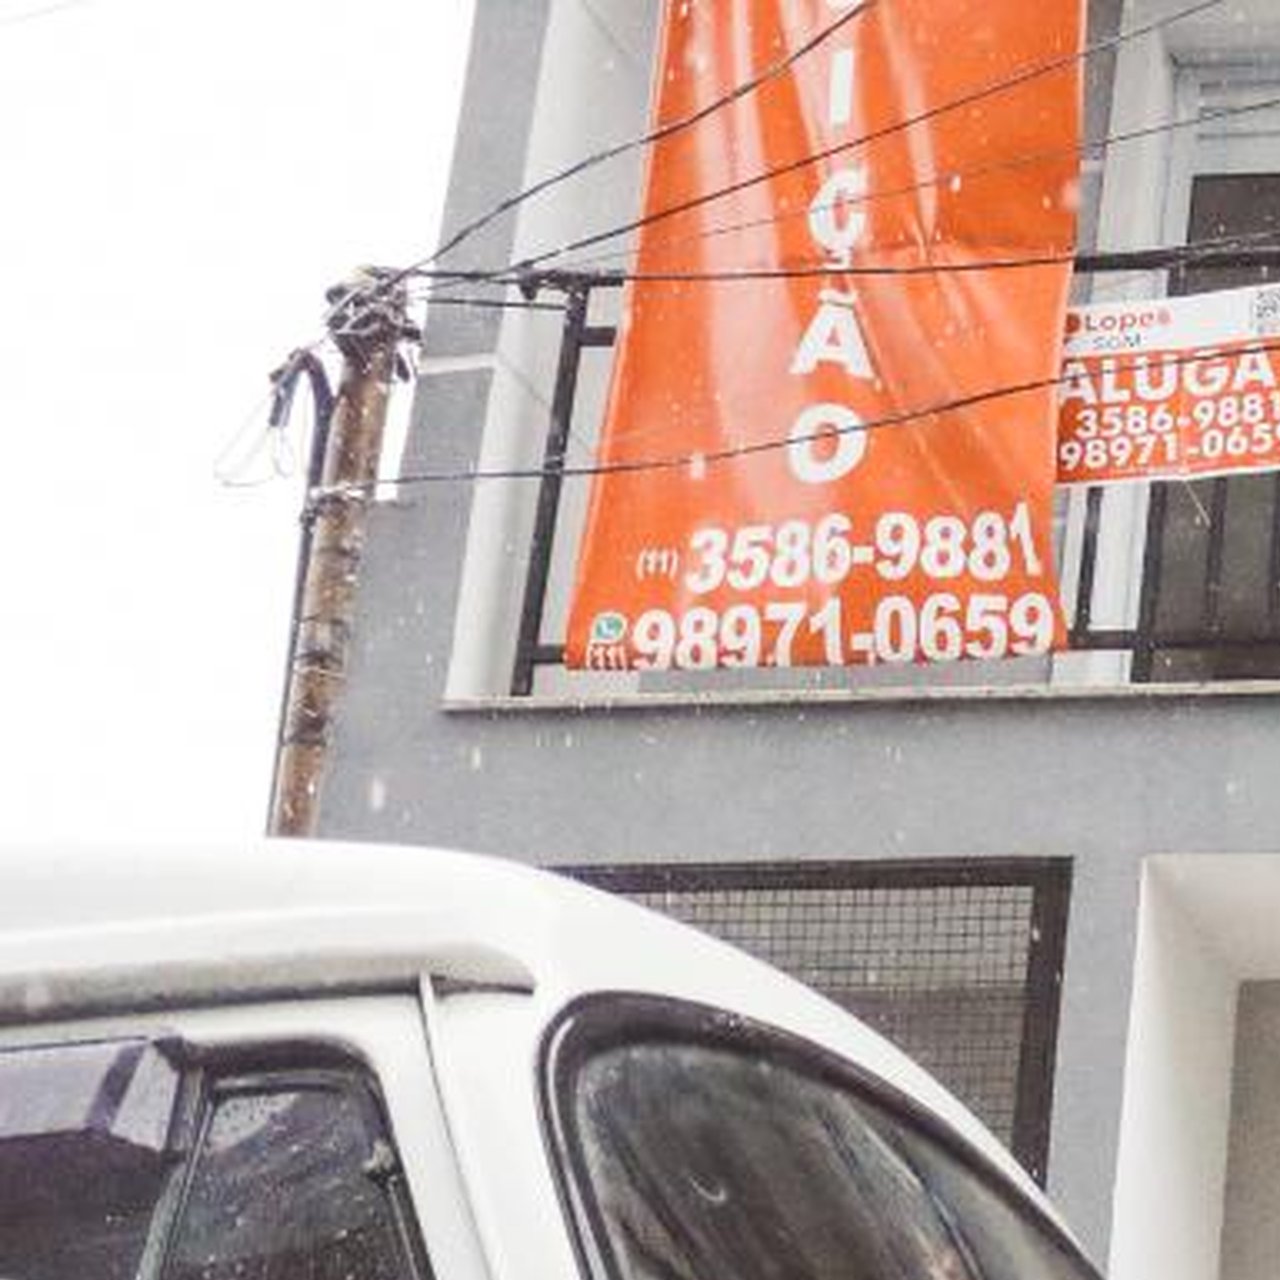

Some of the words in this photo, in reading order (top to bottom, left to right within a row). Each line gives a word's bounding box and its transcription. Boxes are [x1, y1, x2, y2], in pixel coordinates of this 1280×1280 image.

[787, 0, 874, 485] IÇÃO
[1085, 308, 1172, 333] Lopes
[1058, 349, 1277, 406] ALUGA
[636, 546, 679, 581] (11)
[683, 501, 1043, 594] 3586-9881
[632, 591, 1055, 673] 98971-0659
